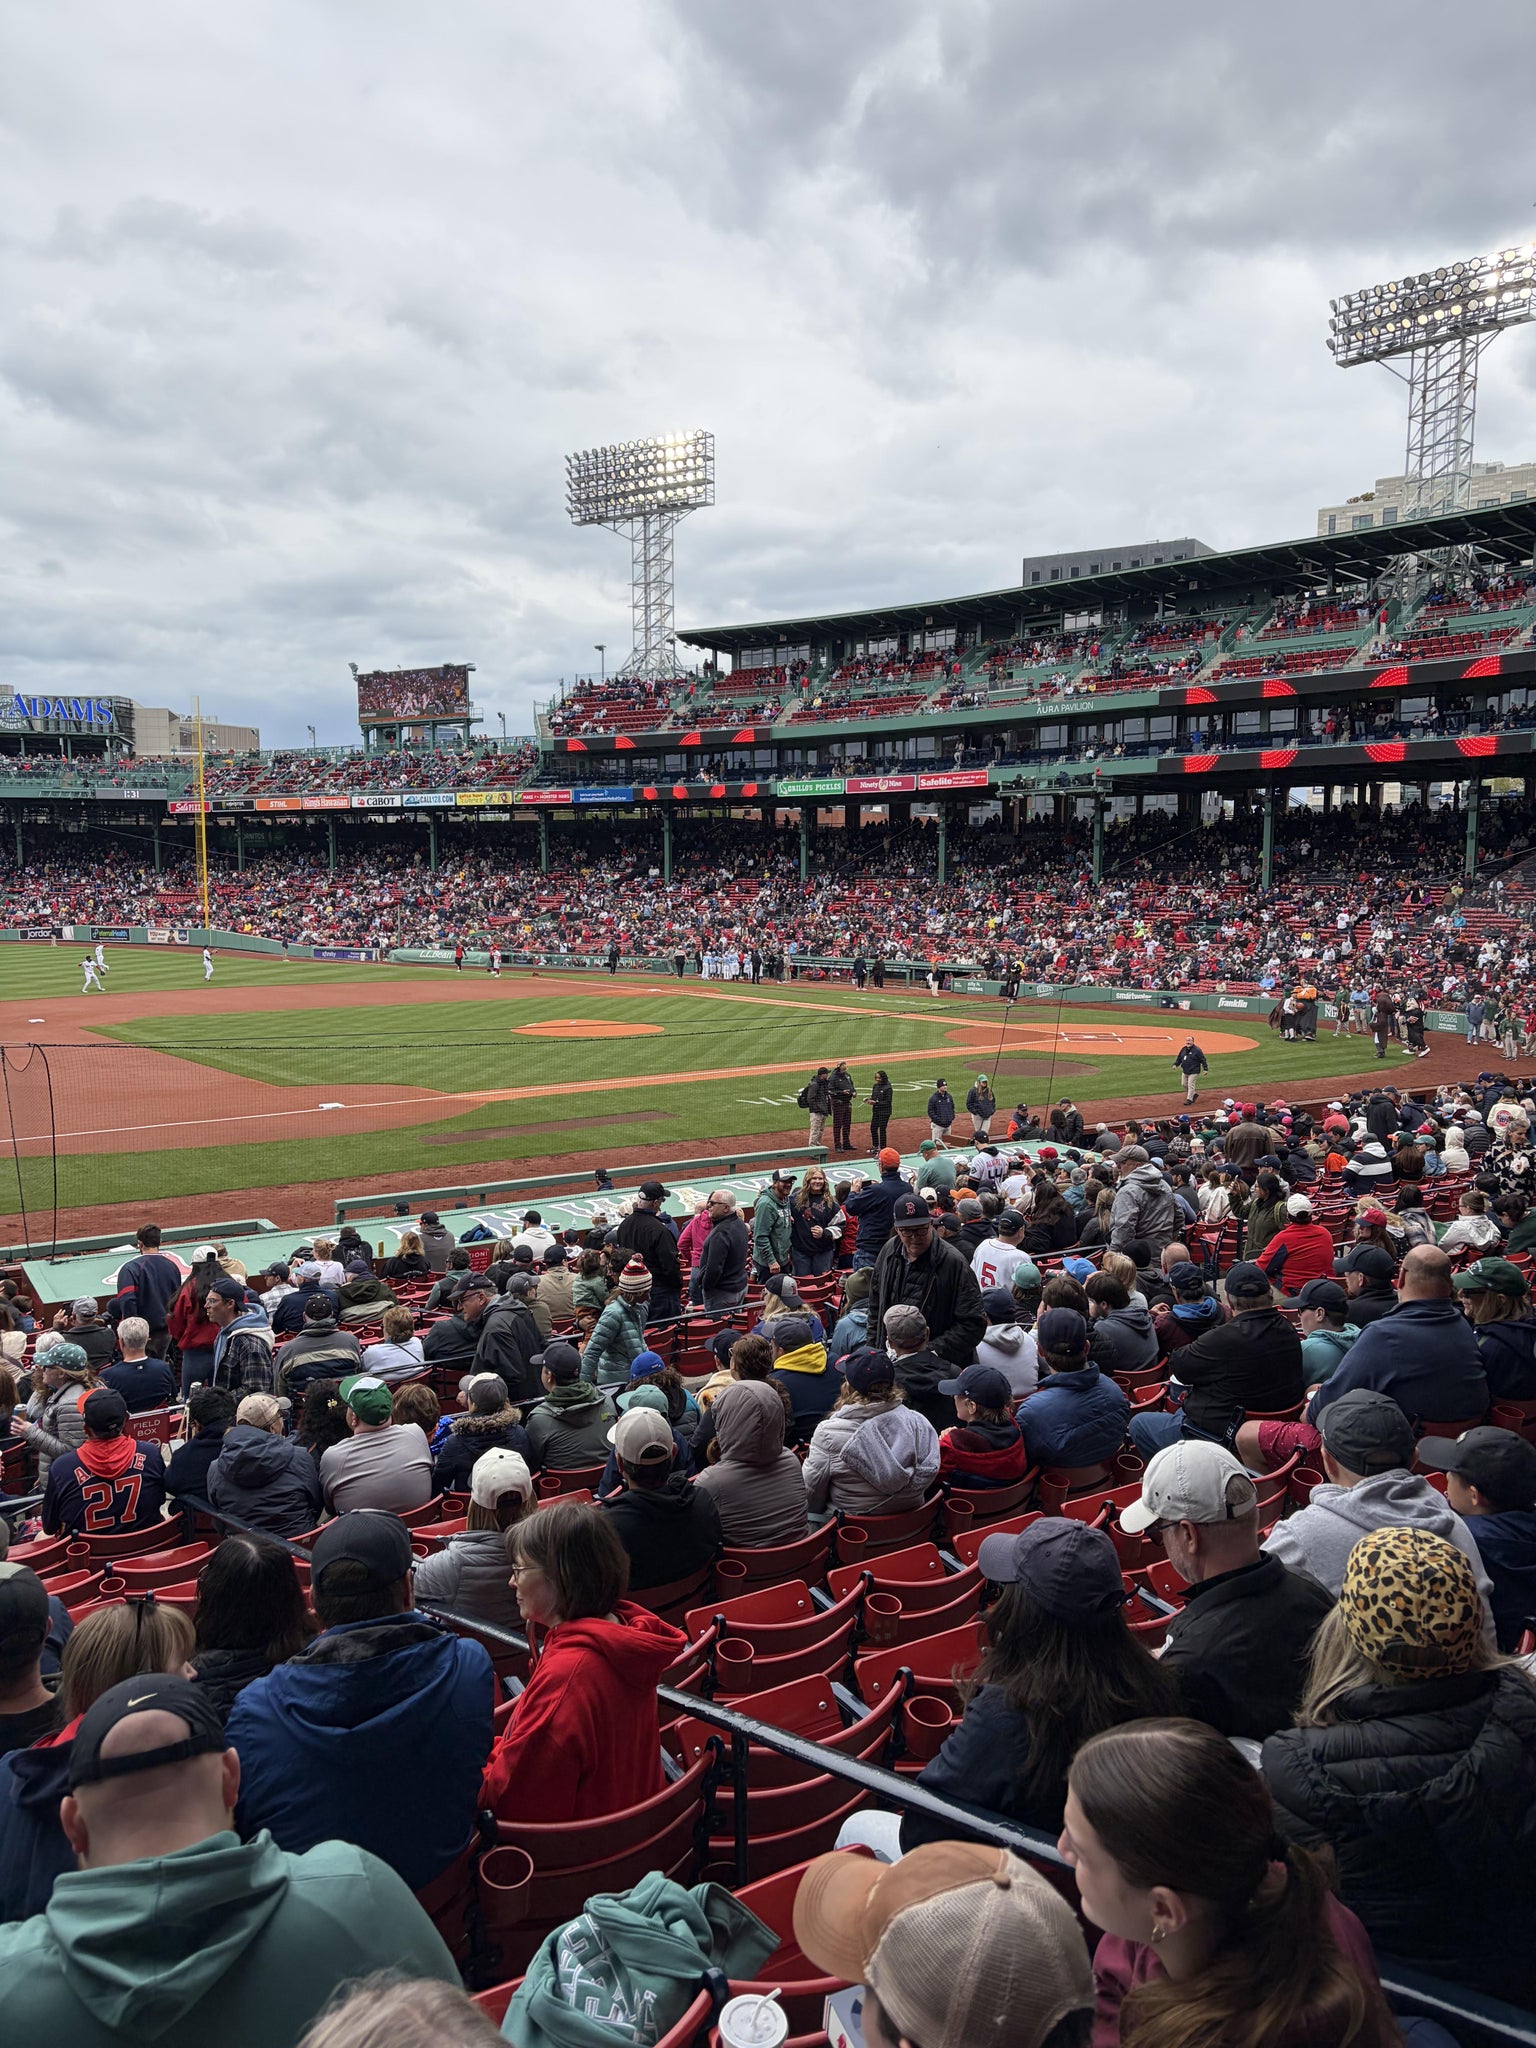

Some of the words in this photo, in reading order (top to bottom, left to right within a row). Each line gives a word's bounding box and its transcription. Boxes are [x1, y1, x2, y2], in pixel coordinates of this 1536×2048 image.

[9, 693, 113, 725] ADAMS
[1061, 701, 1094, 712] PAVILION
[860, 781, 878, 789] Ninety
[920, 777, 952, 786] Safelite
[787, 784, 813, 793] GRILLO'S
[815, 783, 841, 791] PICKLES
[124, 790, 139, 798] 1:31
[419, 950, 453, 959] L.L.Bean
[1115, 992, 1152, 1001] smartwater
[981, 1262, 998, 1288] 5
[133, 1420, 160, 1430] FIELD
[137, 1428, 157, 1437] BOX
[82, 1474, 142, 1531] 27
